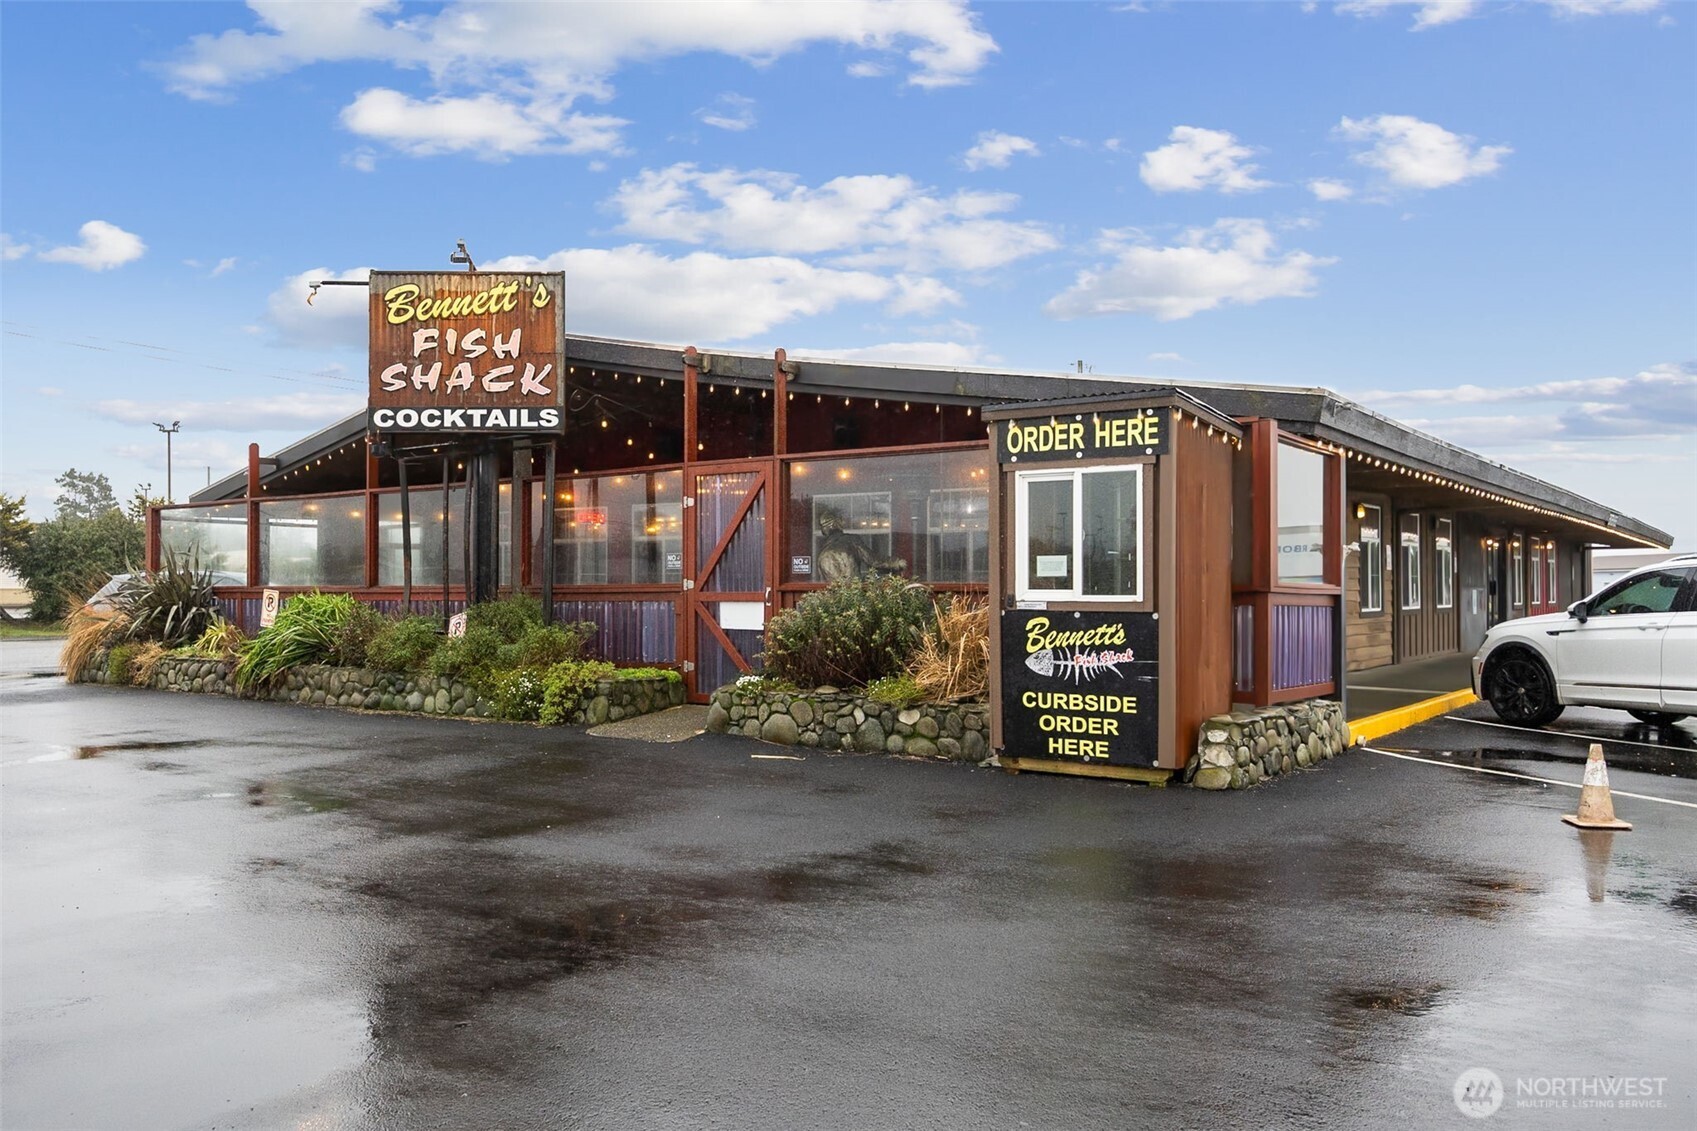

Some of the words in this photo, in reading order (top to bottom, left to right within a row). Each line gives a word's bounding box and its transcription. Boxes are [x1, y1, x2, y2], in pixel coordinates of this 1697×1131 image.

[384, 275, 551, 325] Bennett's
[412, 327, 522, 360] FISH
[379, 361, 553, 396] SHACK
[373, 408, 559, 428] COCKTAILS
[1007, 422, 1085, 454] ORDER
[1094, 416, 1159, 448] HERE
[1025, 616, 1127, 653] Bennett's
[1022, 691, 1137, 714] CURBSIDE
[1039, 714, 1119, 736] ORDER
[1048, 737, 1110, 758] HERE
